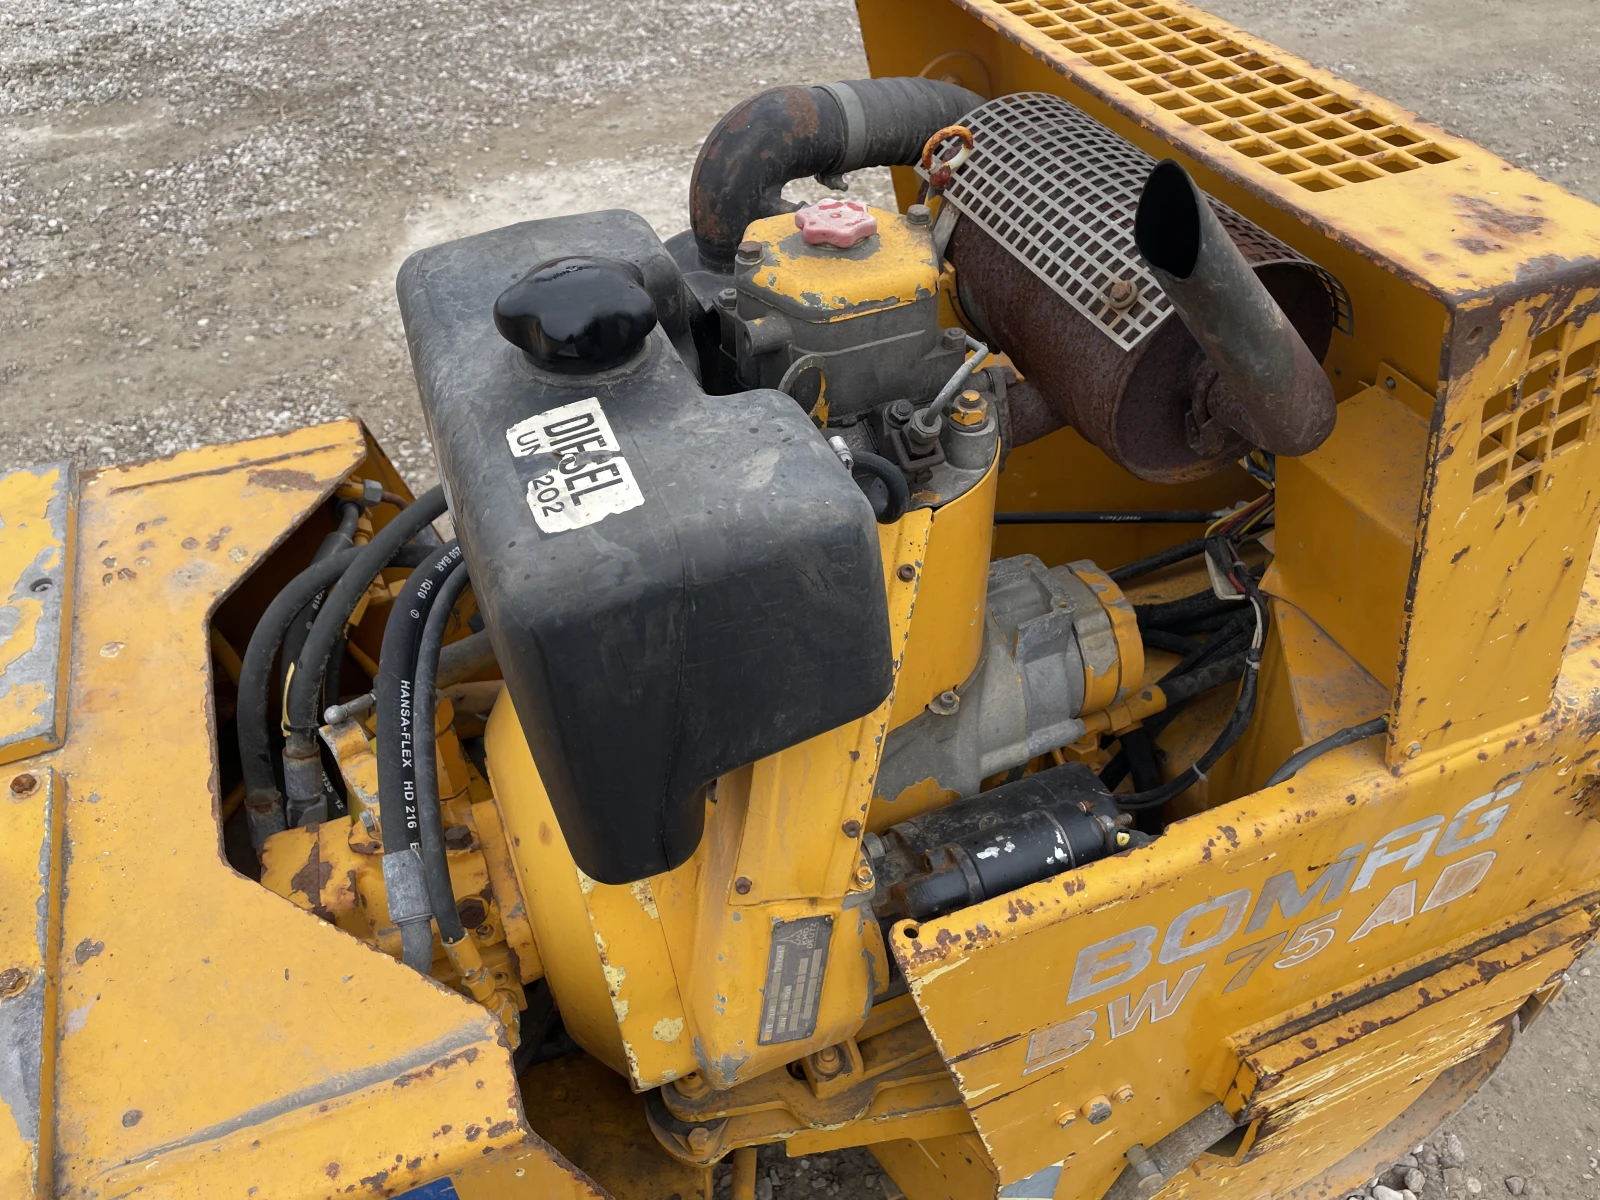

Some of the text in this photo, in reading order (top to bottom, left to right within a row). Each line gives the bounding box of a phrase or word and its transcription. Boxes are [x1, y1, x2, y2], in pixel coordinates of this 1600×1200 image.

[533, 475, 565, 517] 202
[434, 555, 452, 572] BAR
[417, 578, 434, 599] 1Q10
[400, 679, 412, 768] HANSA-FLEX
[403, 780, 414, 801] HD
[405, 805, 417, 829] 216
[1066, 781, 1523, 1005] BOMAG
[806, 922, 818, 949] DEUTZ
[1022, 850, 1497, 1076] BW 75 AD
